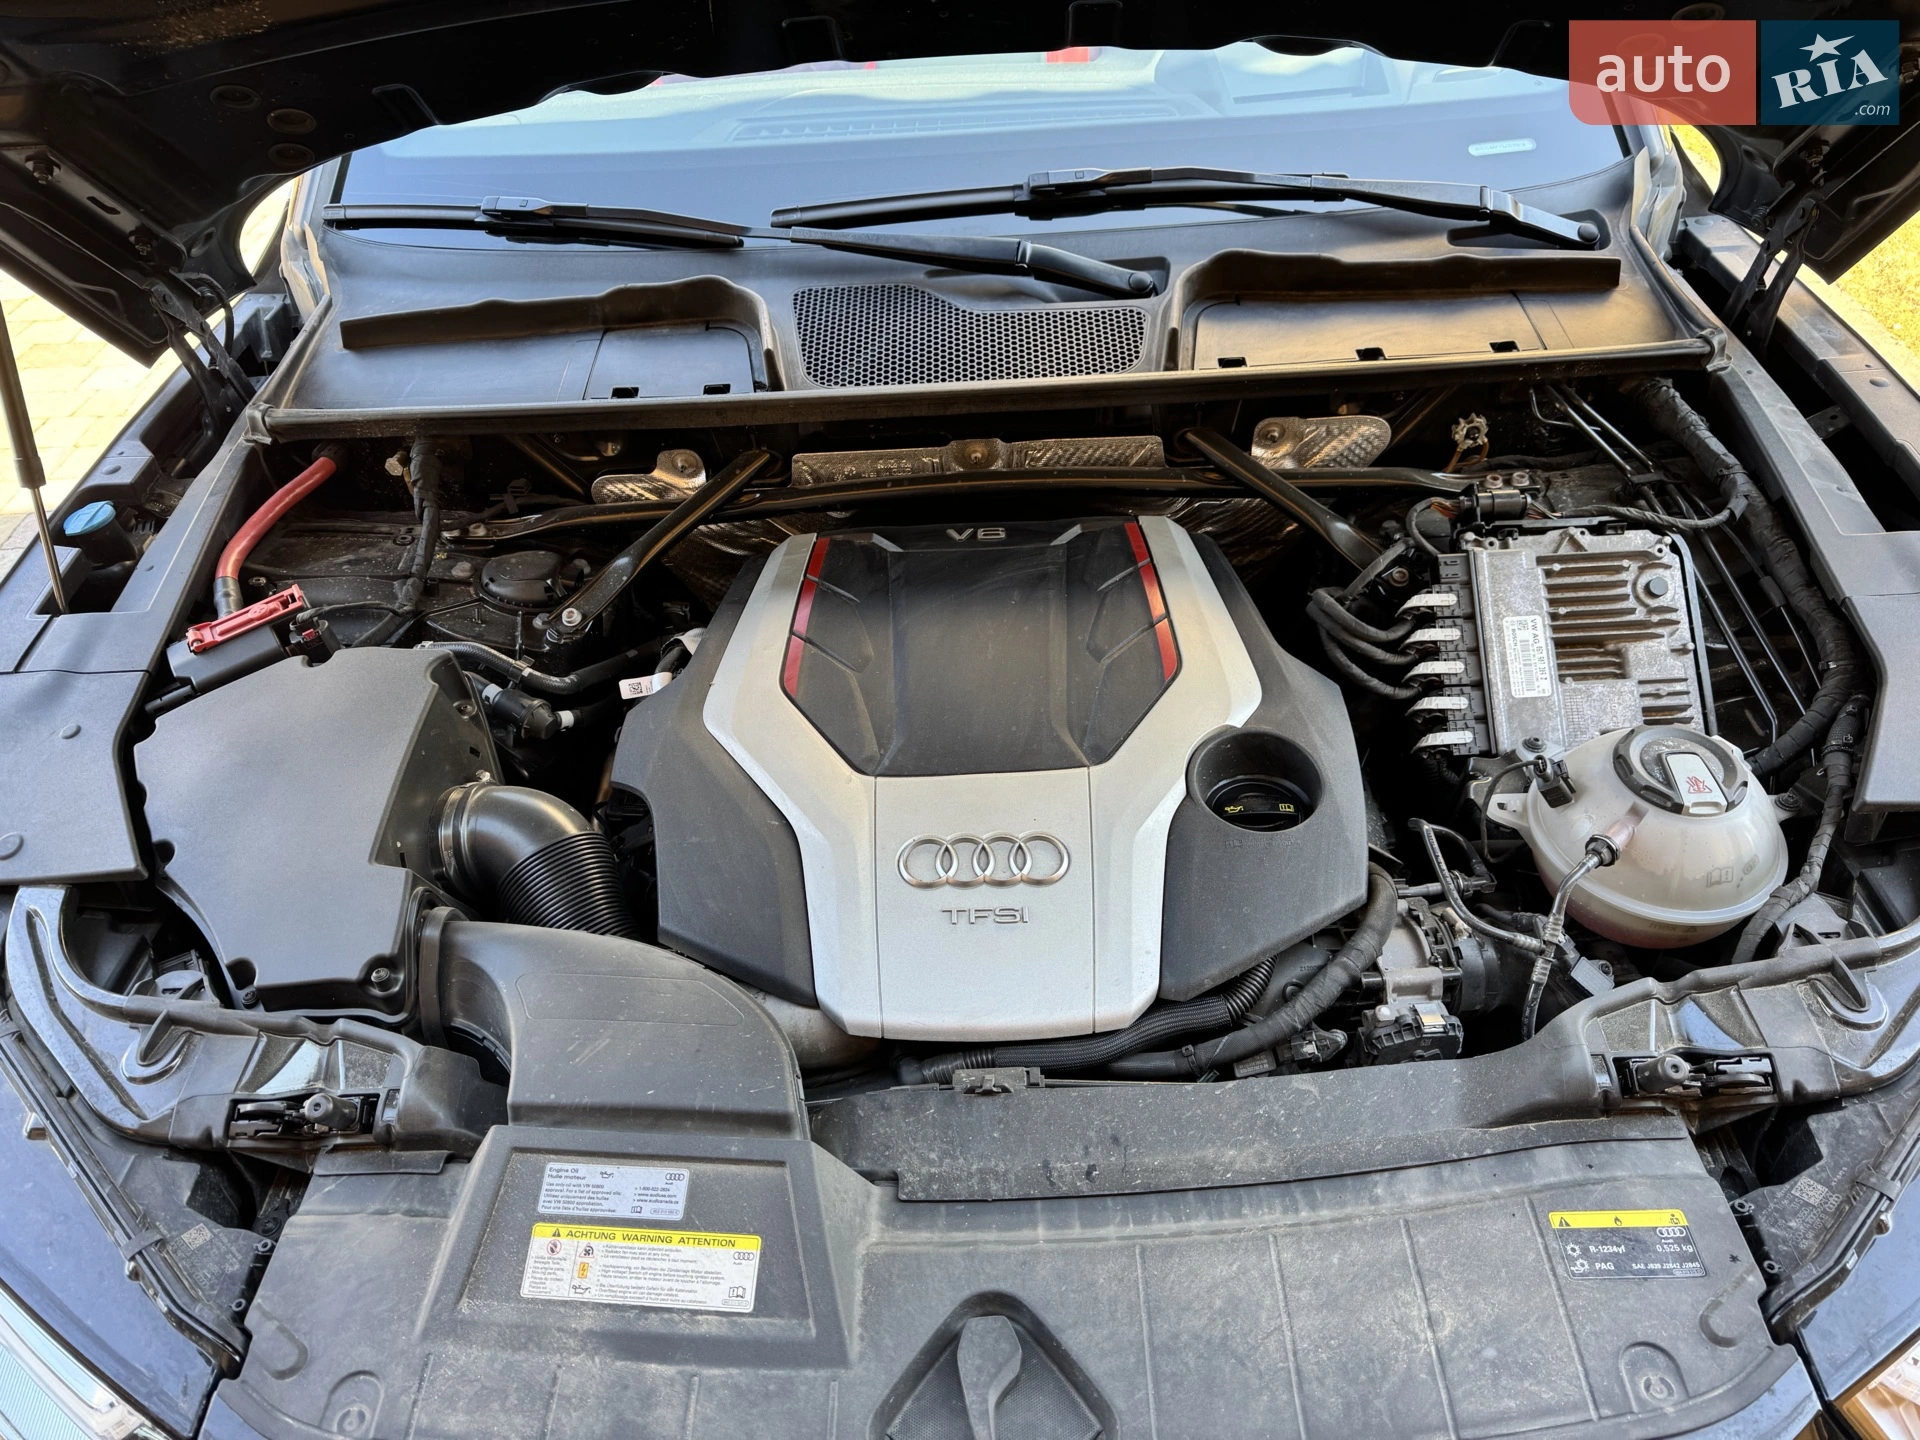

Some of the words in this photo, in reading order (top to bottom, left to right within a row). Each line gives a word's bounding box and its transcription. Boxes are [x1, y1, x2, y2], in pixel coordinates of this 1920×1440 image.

[946, 527, 1007, 541] V6
[941, 905, 1029, 925] TFSI
[566, 1230, 616, 1240] ACHTUNG
[622, 1233, 673, 1244] WARNING
[678, 1237, 736, 1248] ATTENTION
[1588, 1245, 1626, 1254] R-1234yf
[1656, 1244, 1680, 1252] 0,525
[1682, 1244, 1694, 1252] kg
[1595, 1262, 1615, 1270] PAG
